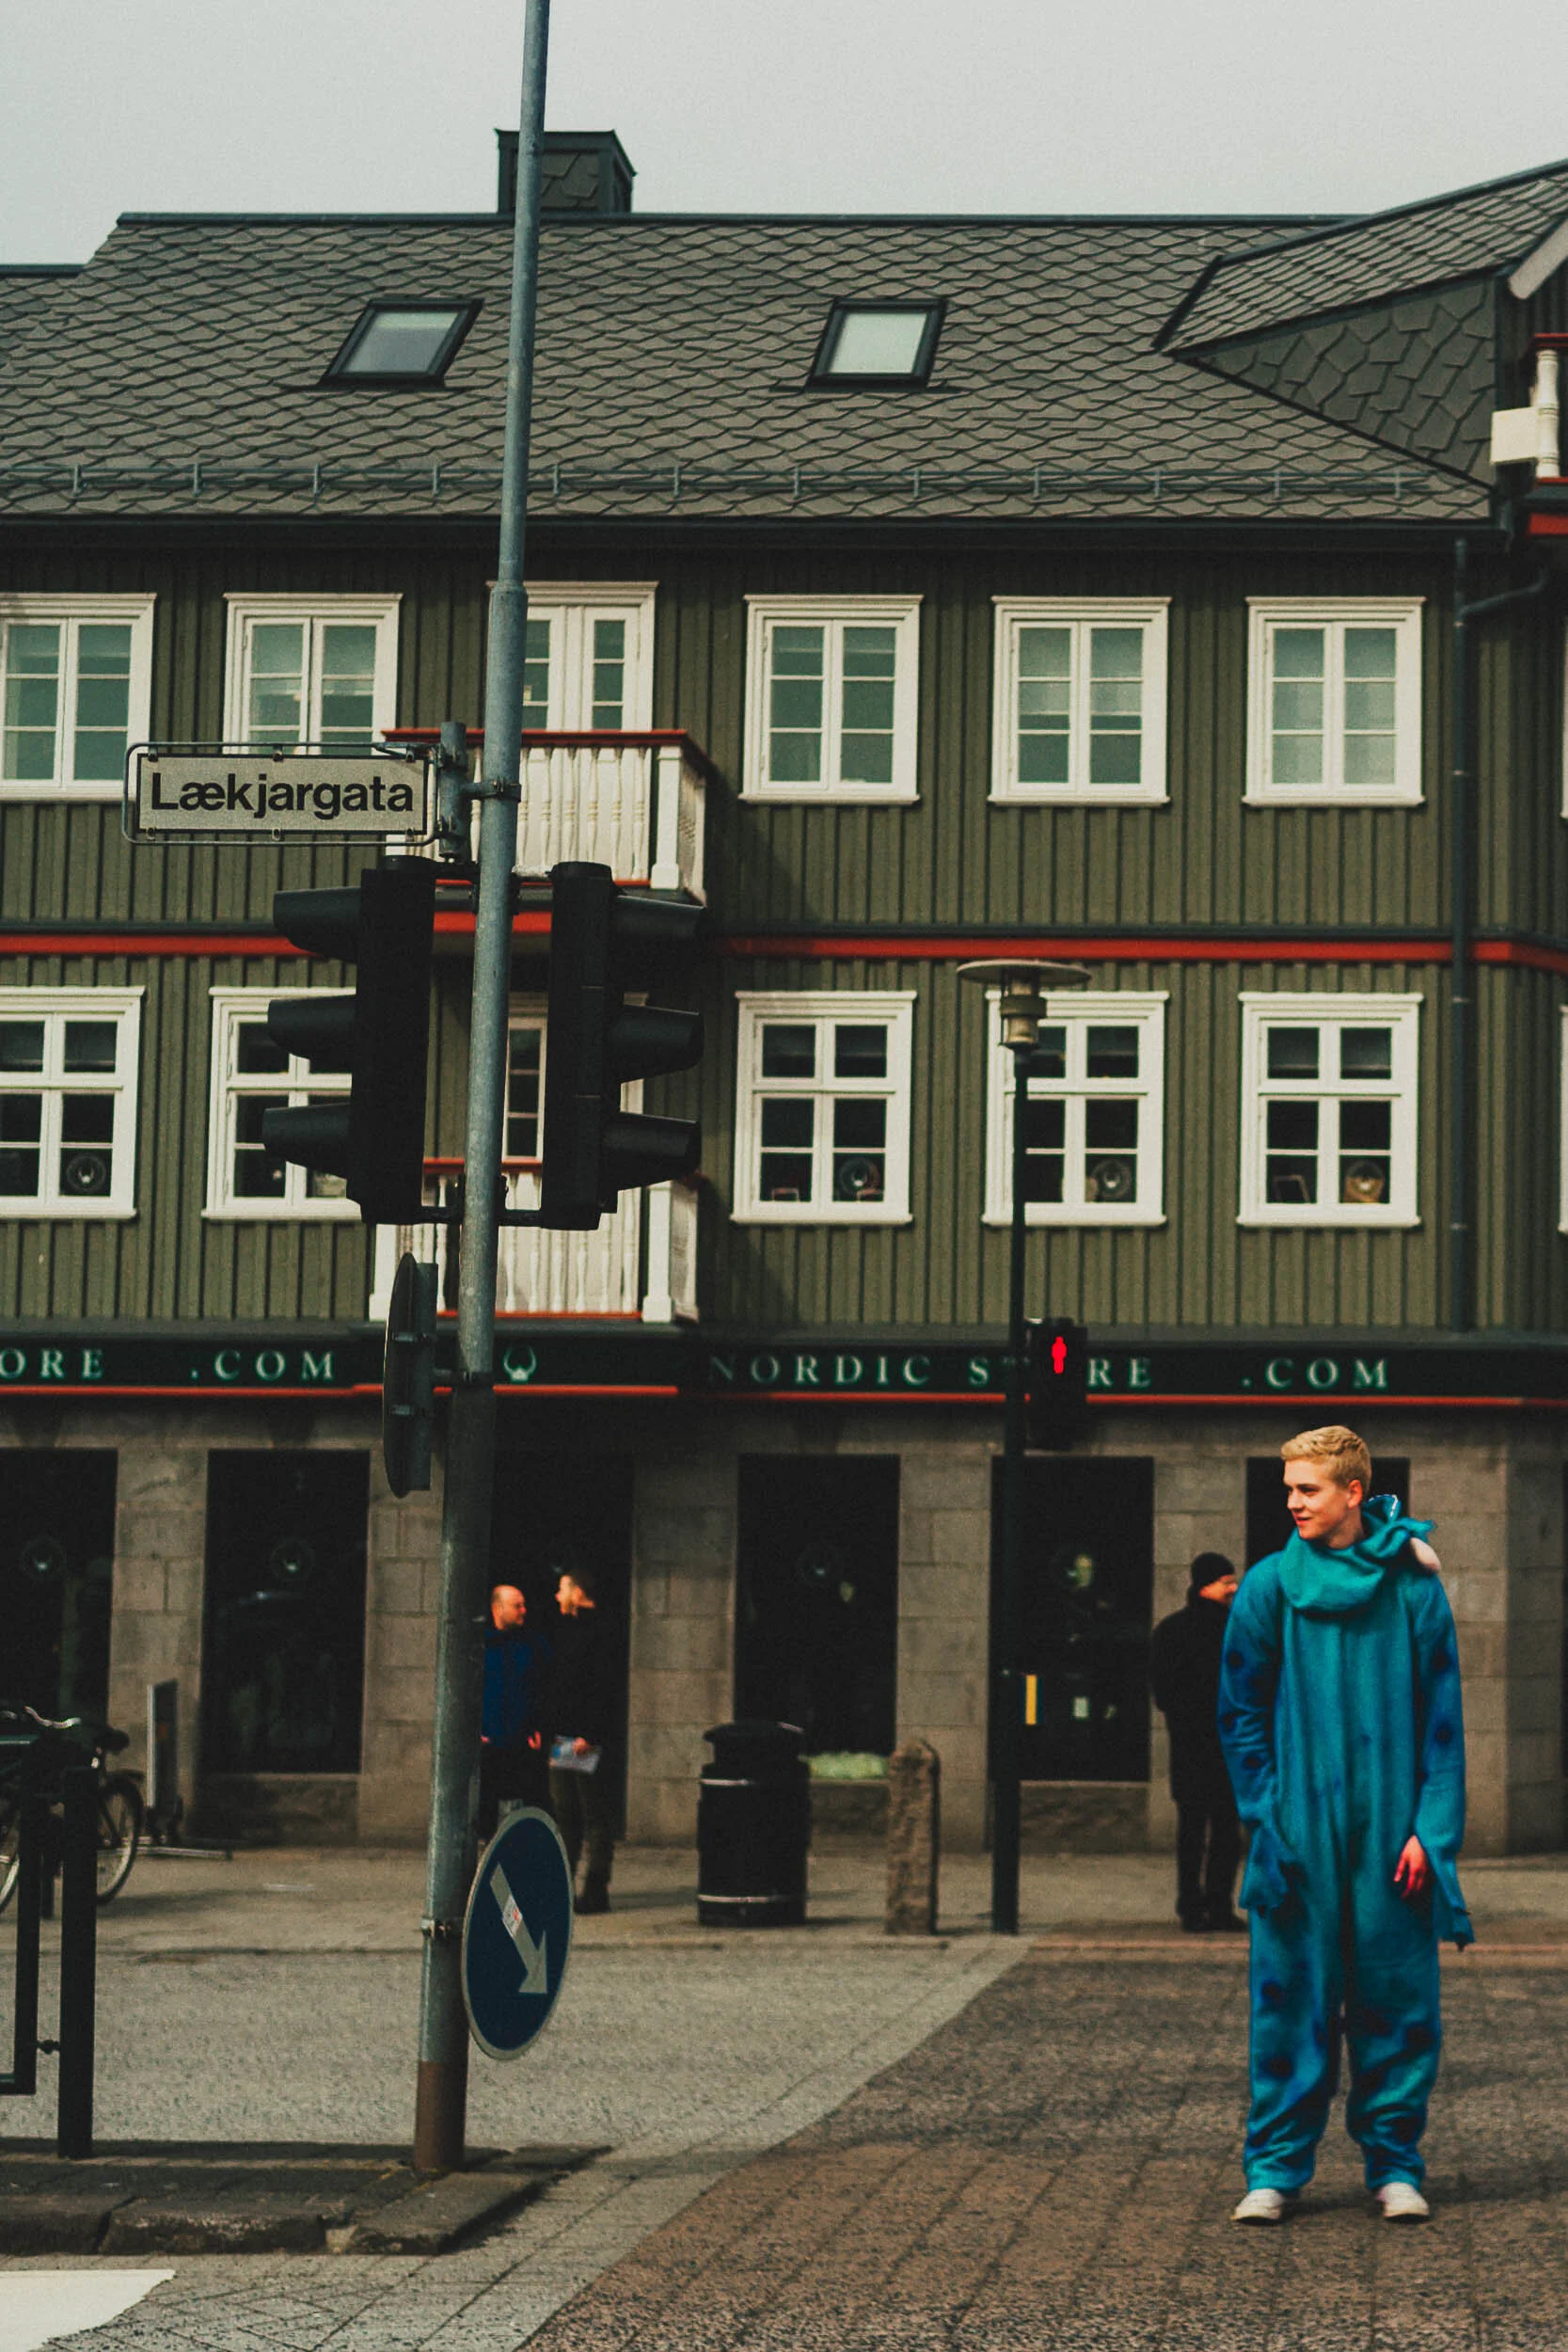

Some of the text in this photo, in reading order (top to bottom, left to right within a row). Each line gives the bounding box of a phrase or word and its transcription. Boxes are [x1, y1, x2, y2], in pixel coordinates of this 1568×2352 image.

[150, 772, 414, 820] Lækjargata
[190, 1349, 335, 1381] .COM
[709, 1355, 1387, 1389] NORDIC SRE .COM
